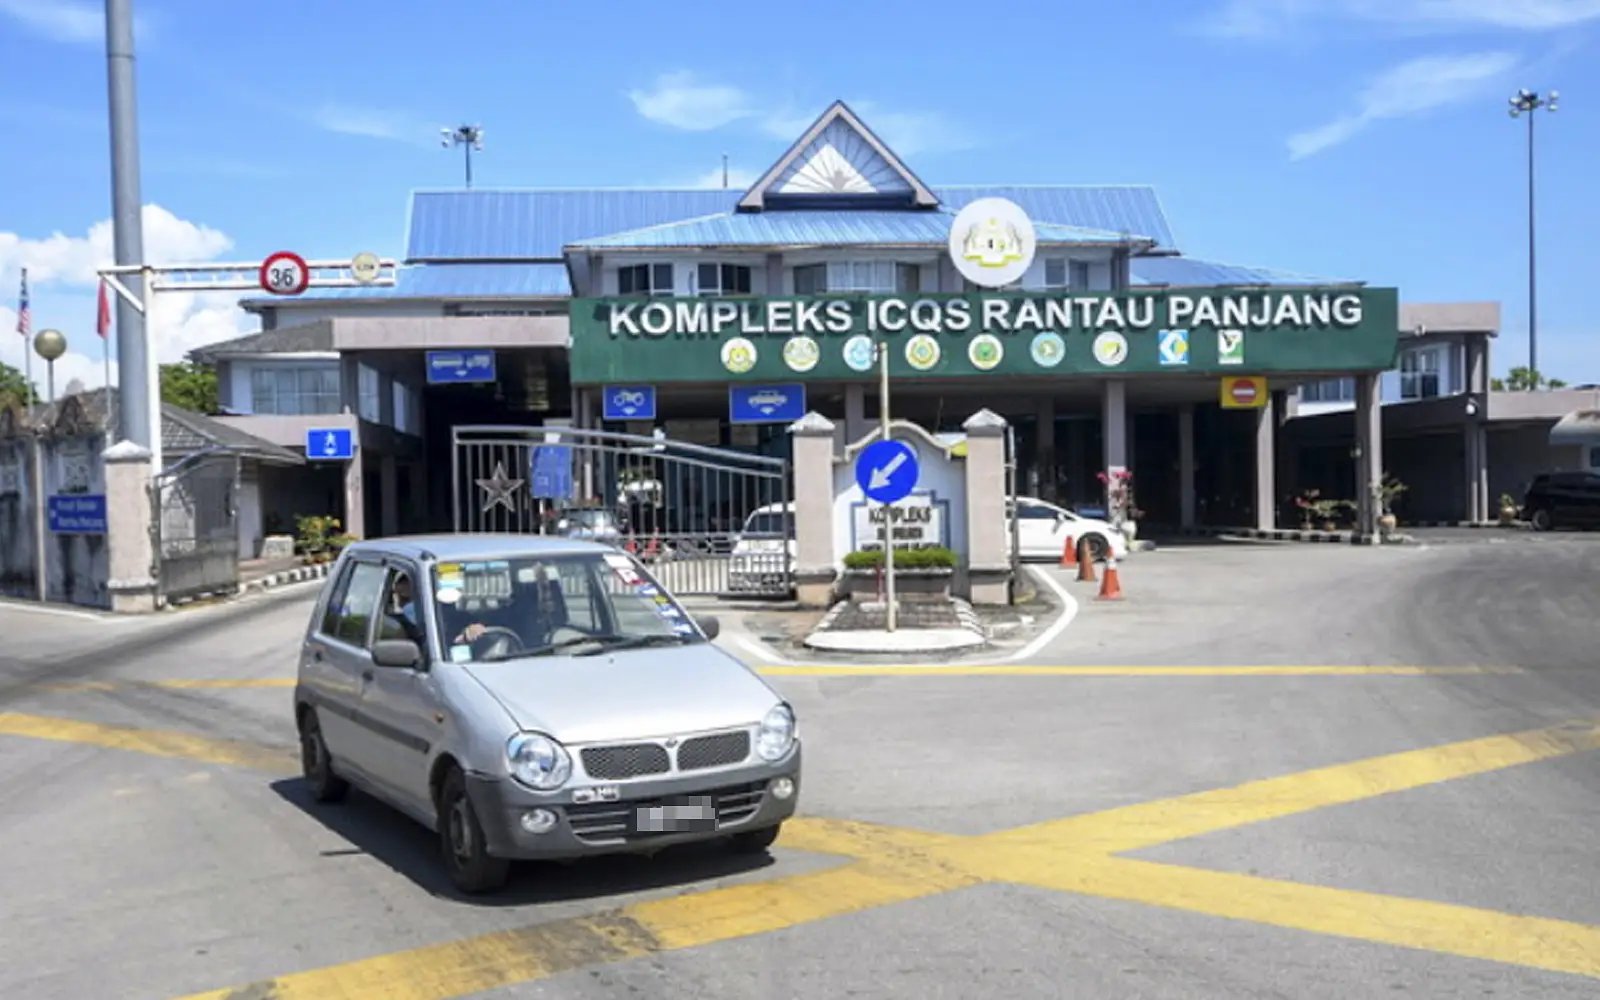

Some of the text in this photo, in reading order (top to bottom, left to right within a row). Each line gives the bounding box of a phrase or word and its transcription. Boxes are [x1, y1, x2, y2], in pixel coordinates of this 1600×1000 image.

[609, 294, 1362, 335] KOMPLEKS ICQS RANTAU PANJANG
